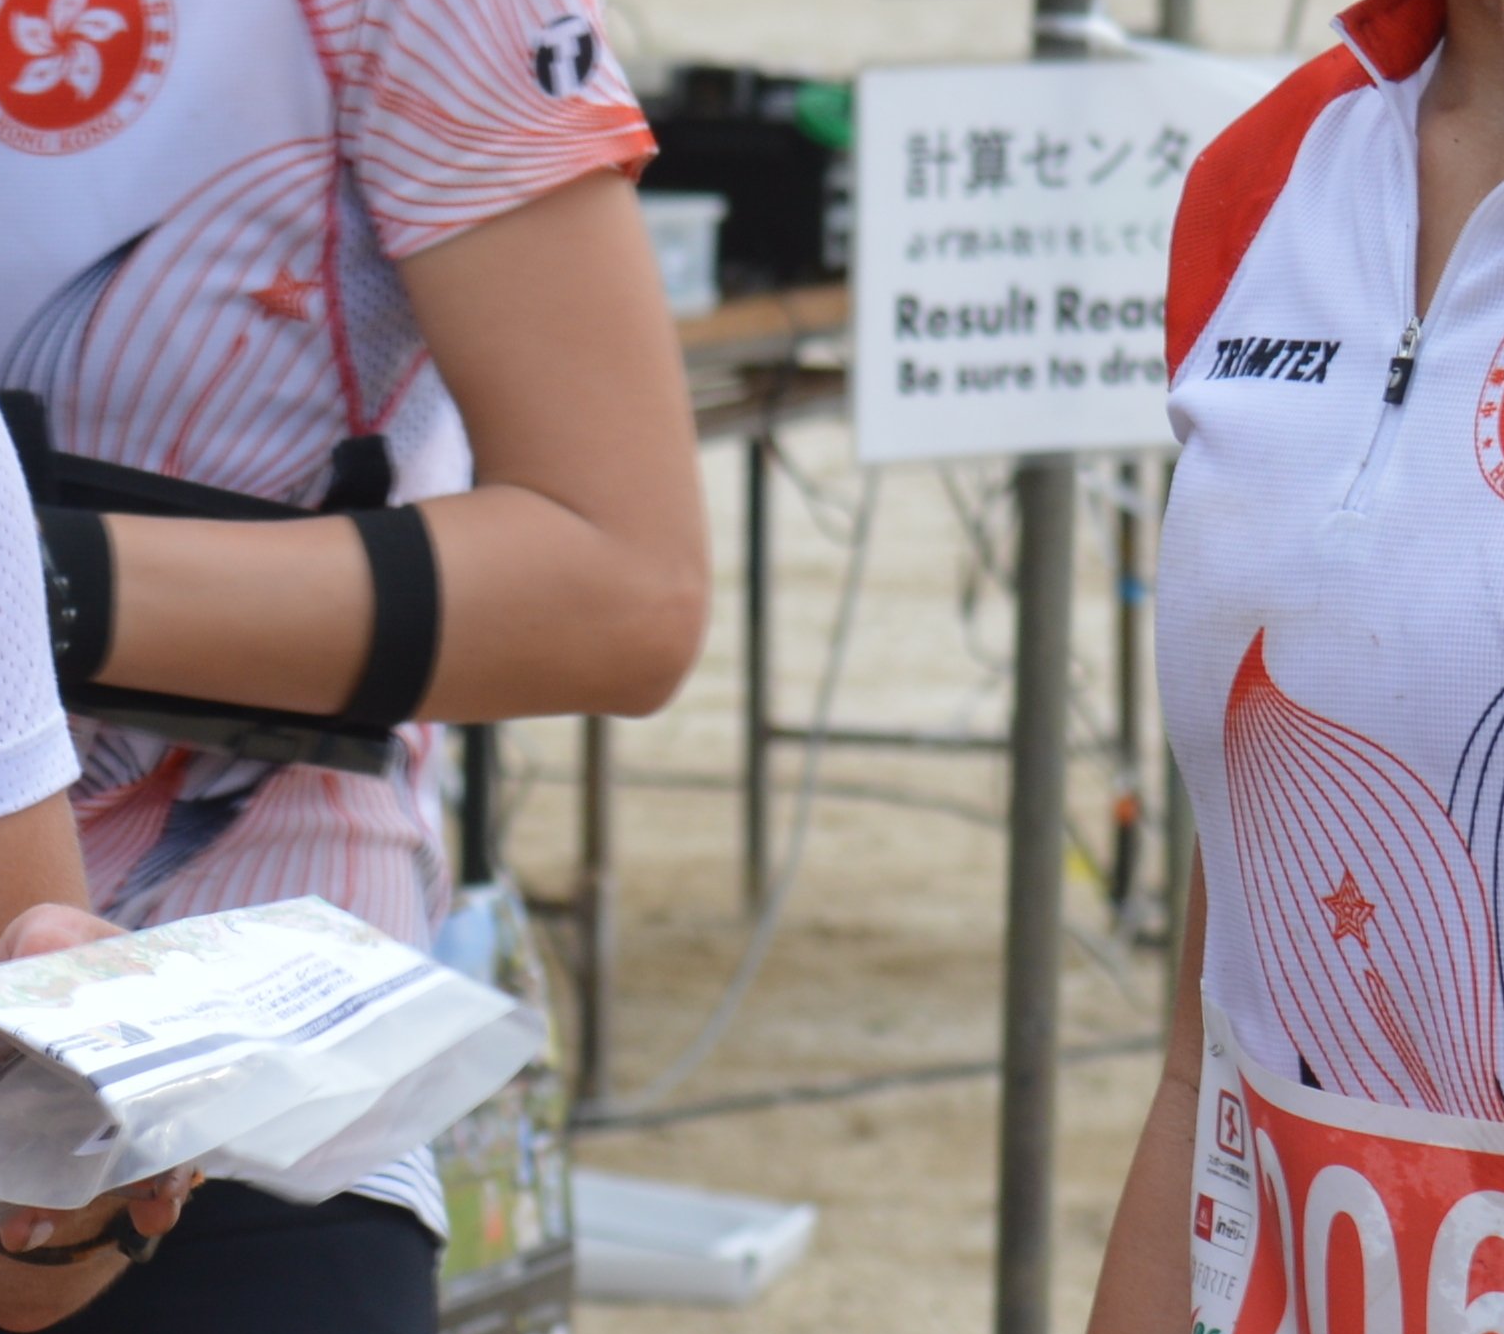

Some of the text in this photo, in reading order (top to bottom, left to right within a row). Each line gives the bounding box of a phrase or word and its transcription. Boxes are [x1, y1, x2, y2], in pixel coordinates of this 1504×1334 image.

[894, 282, 1037, 341] Result
[897, 354, 942, 396] Be
[955, 360, 1034, 394] sure
[1048, 353, 1087, 388] to
[1204, 336, 1342, 386] TRIMTEX
